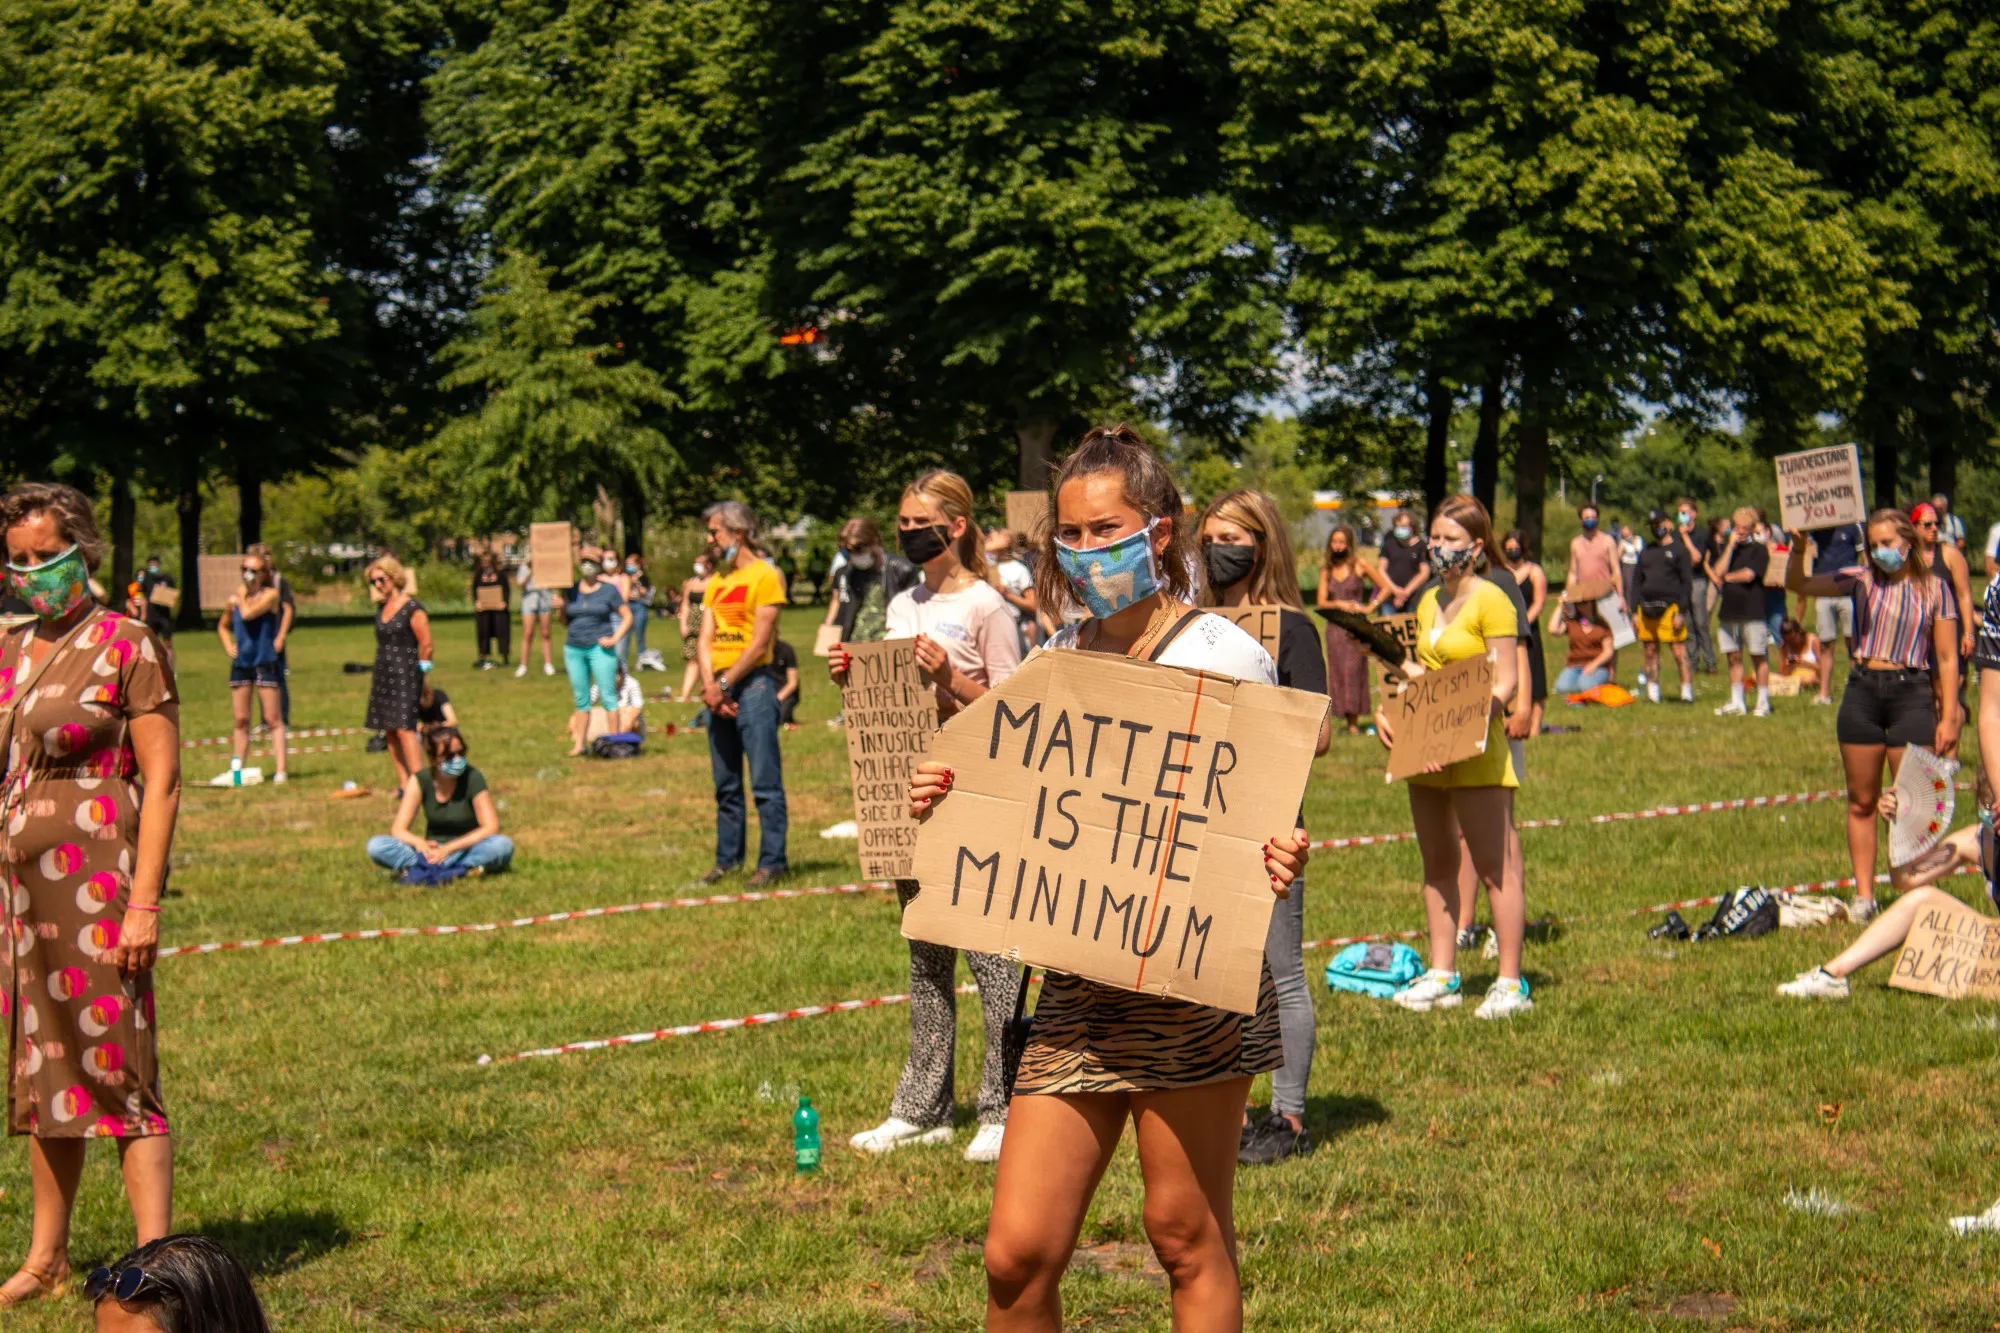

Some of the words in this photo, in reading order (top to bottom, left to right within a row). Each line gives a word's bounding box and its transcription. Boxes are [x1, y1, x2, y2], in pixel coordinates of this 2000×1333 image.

[1803, 503, 1837, 523] YOU
[858, 652, 889, 687] YOU
[841, 683, 901, 710] NEUTRAL
[917, 707, 935, 730] OF
[854, 757, 881, 781] YOU
[883, 755, 914, 780] HAVE
[989, 699, 1238, 814] MATTER
[857, 782, 905, 801] CHOSEN
[1032, 786, 1082, 850] IS
[1102, 792, 1208, 882] THE
[951, 846, 1213, 980] MINIMUM
[1895, 945, 1969, 994] BLACK
